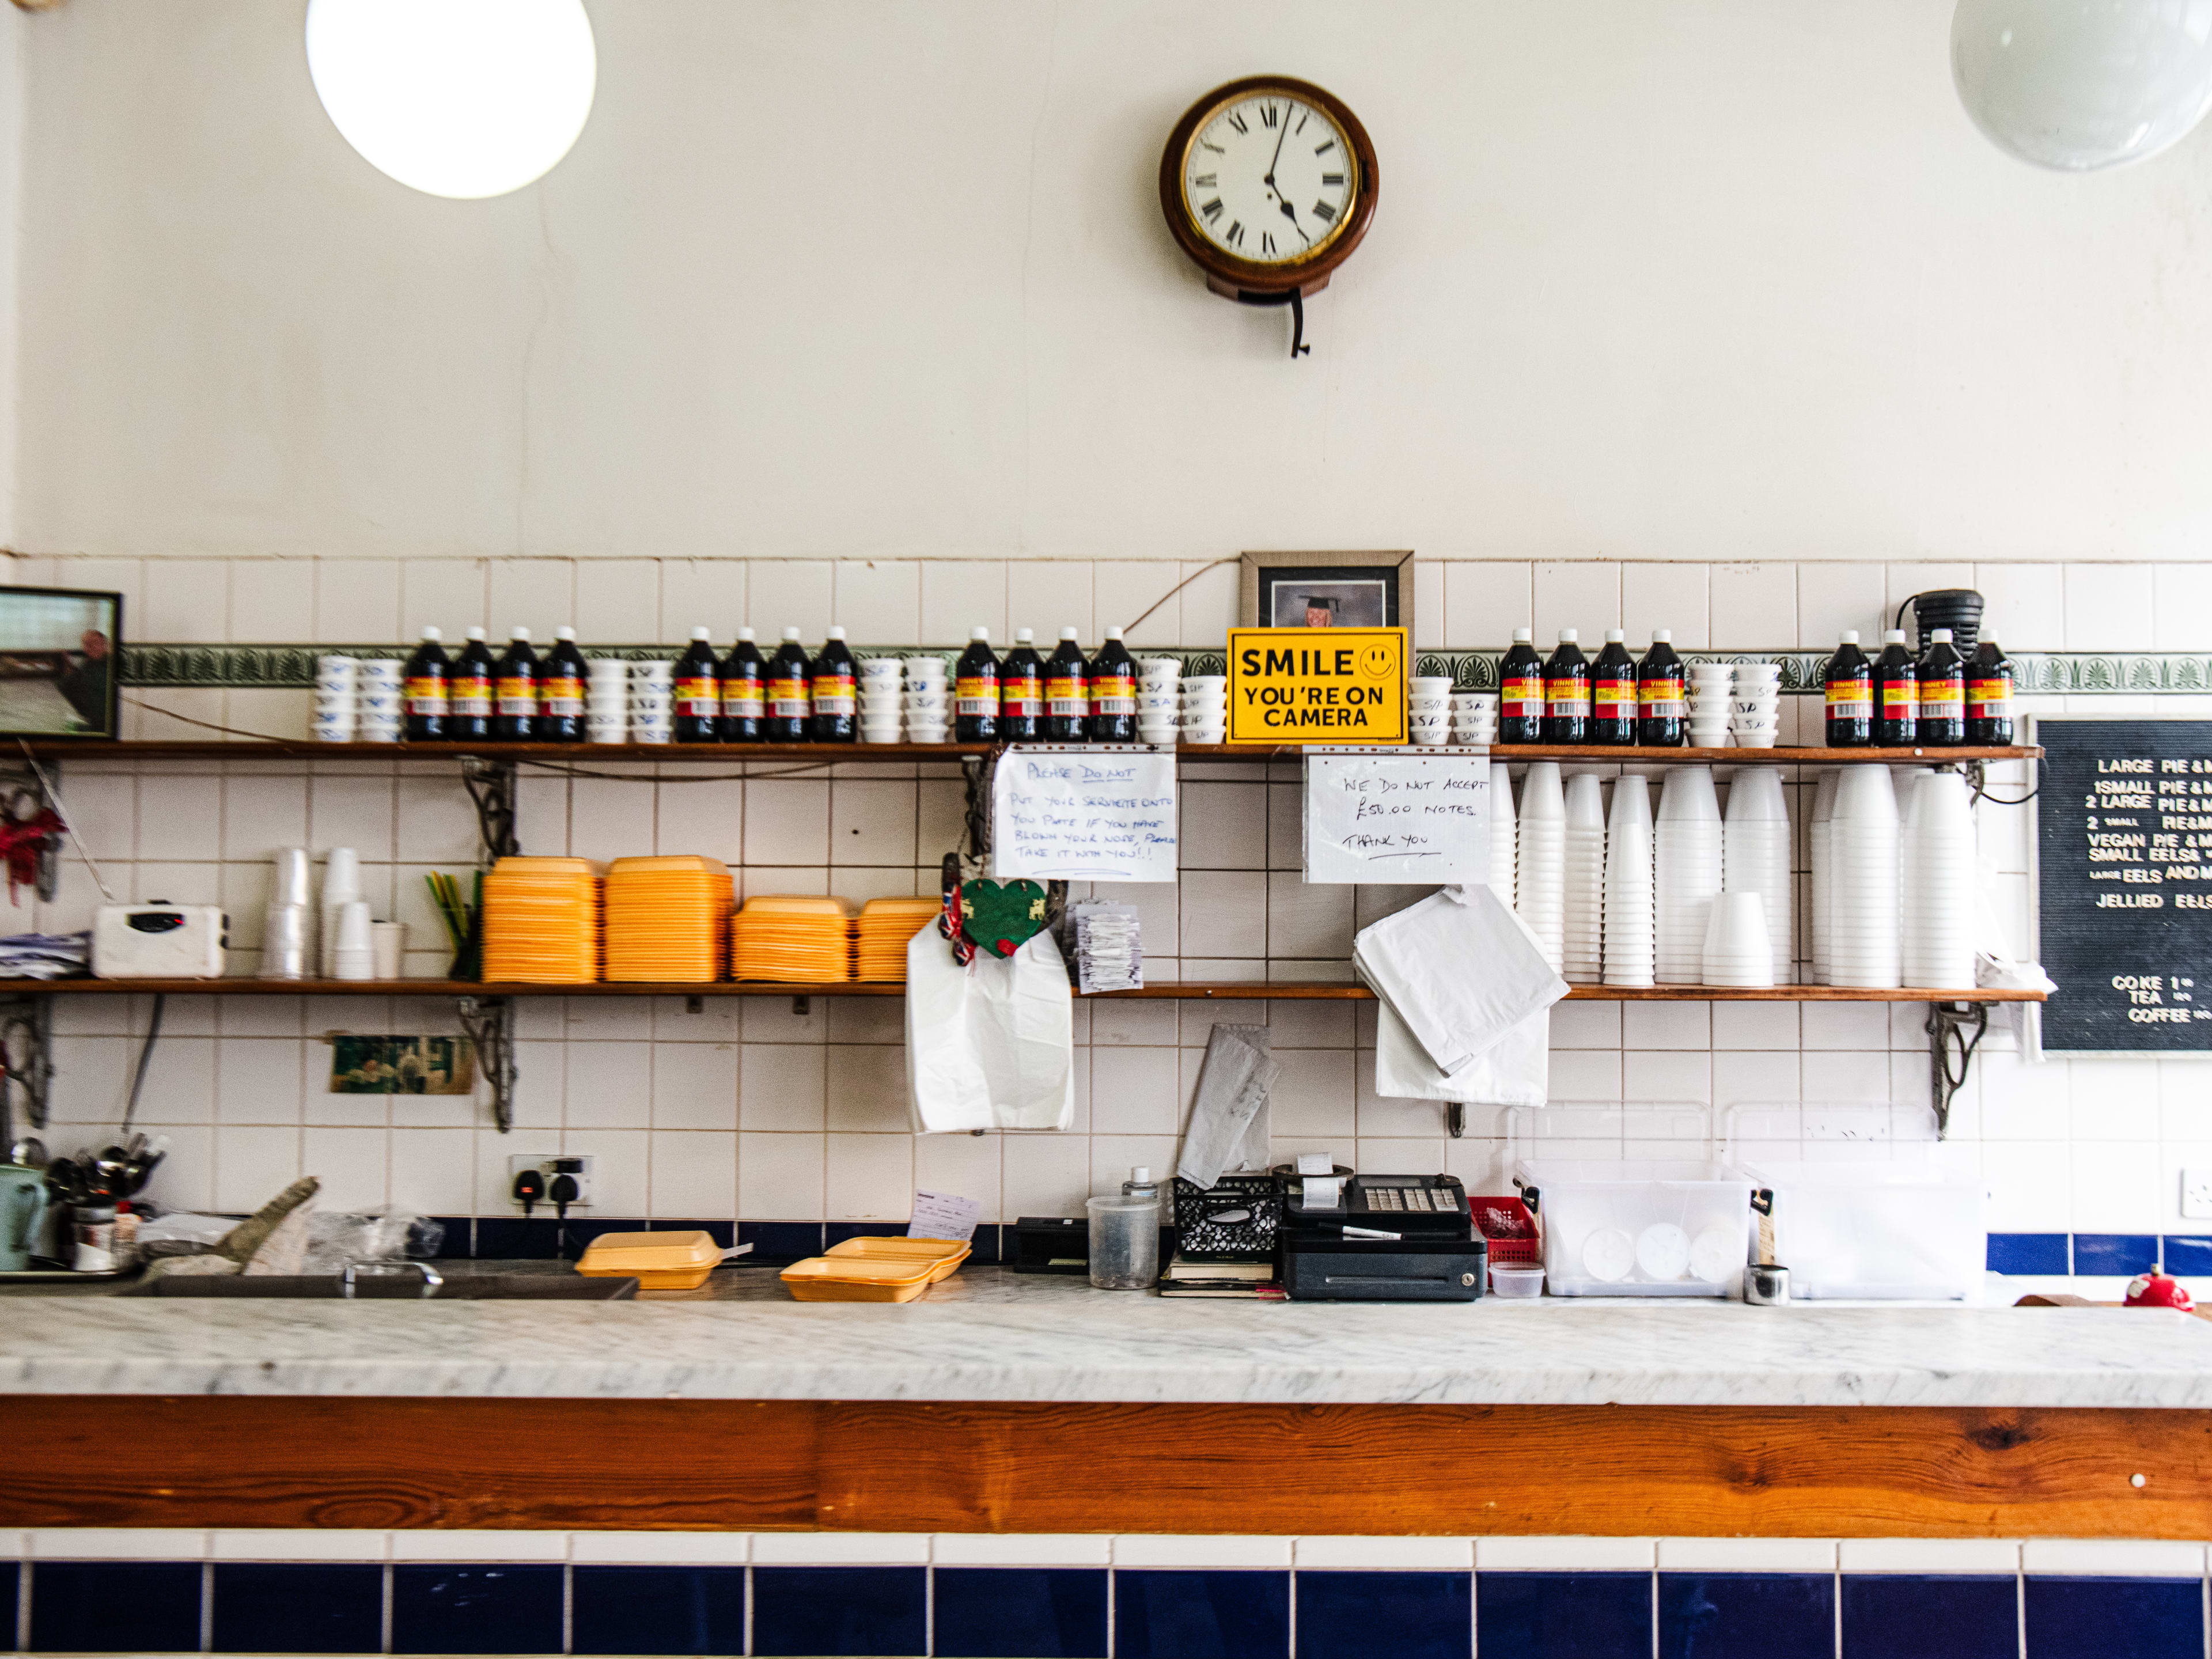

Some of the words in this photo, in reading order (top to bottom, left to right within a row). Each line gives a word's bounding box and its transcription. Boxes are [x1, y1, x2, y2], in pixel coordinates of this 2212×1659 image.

[1241, 649, 1354, 676] SMILE
[1244, 686, 1339, 705] YOU'RE
[1346, 687, 1383, 705] ON
[1264, 709, 1369, 727] CAMERA
[1078, 764, 1102, 778] DO
[1107, 768, 1137, 778] NOT
[2097, 759, 2154, 774] LARGE
[2161, 759, 2189, 774] PIE
[1343, 778, 1370, 793] WE
[1379, 778, 1398, 794] DO
[1406, 781, 1435, 791] NOT
[1442, 779, 1489, 790] ACCEPT
[2158, 780, 2188, 795] PIE
[1009, 792, 1033, 806] PUT
[1141, 798, 1173, 807] ONTO
[2085, 794, 2097, 809] 2
[2101, 794, 2152, 809] LARGE
[1356, 797, 1411, 821] £50.00
[1085, 817, 1101, 828] IF
[1104, 820, 1127, 829] YOU
[1132, 819, 1165, 830] HAVE
[2086, 816, 2099, 830] 2
[2104, 817, 2139, 827] SMALL
[1063, 834, 1097, 843] YOUR
[1342, 834, 1395, 847] THANK
[1401, 836, 1429, 847] YOU
[2087, 833, 2146, 847] VEGAN
[2153, 833, 2180, 848] PIE
[1014, 845, 1048, 858] TAKE
[1056, 849, 1071, 858] IT
[1074, 850, 1101, 858] WITH
[2088, 847, 2145, 862] SMALL
[2089, 870, 2122, 880] LARGE
[2122, 869, 2163, 884] EELS
[2165, 865, 2200, 880] AND
[2095, 893, 2165, 908] JELLIED
[2111, 975, 2164, 991] COKE
[2128, 990, 2164, 1005] TEA
[2127, 1008, 2192, 1024] COFFEE
